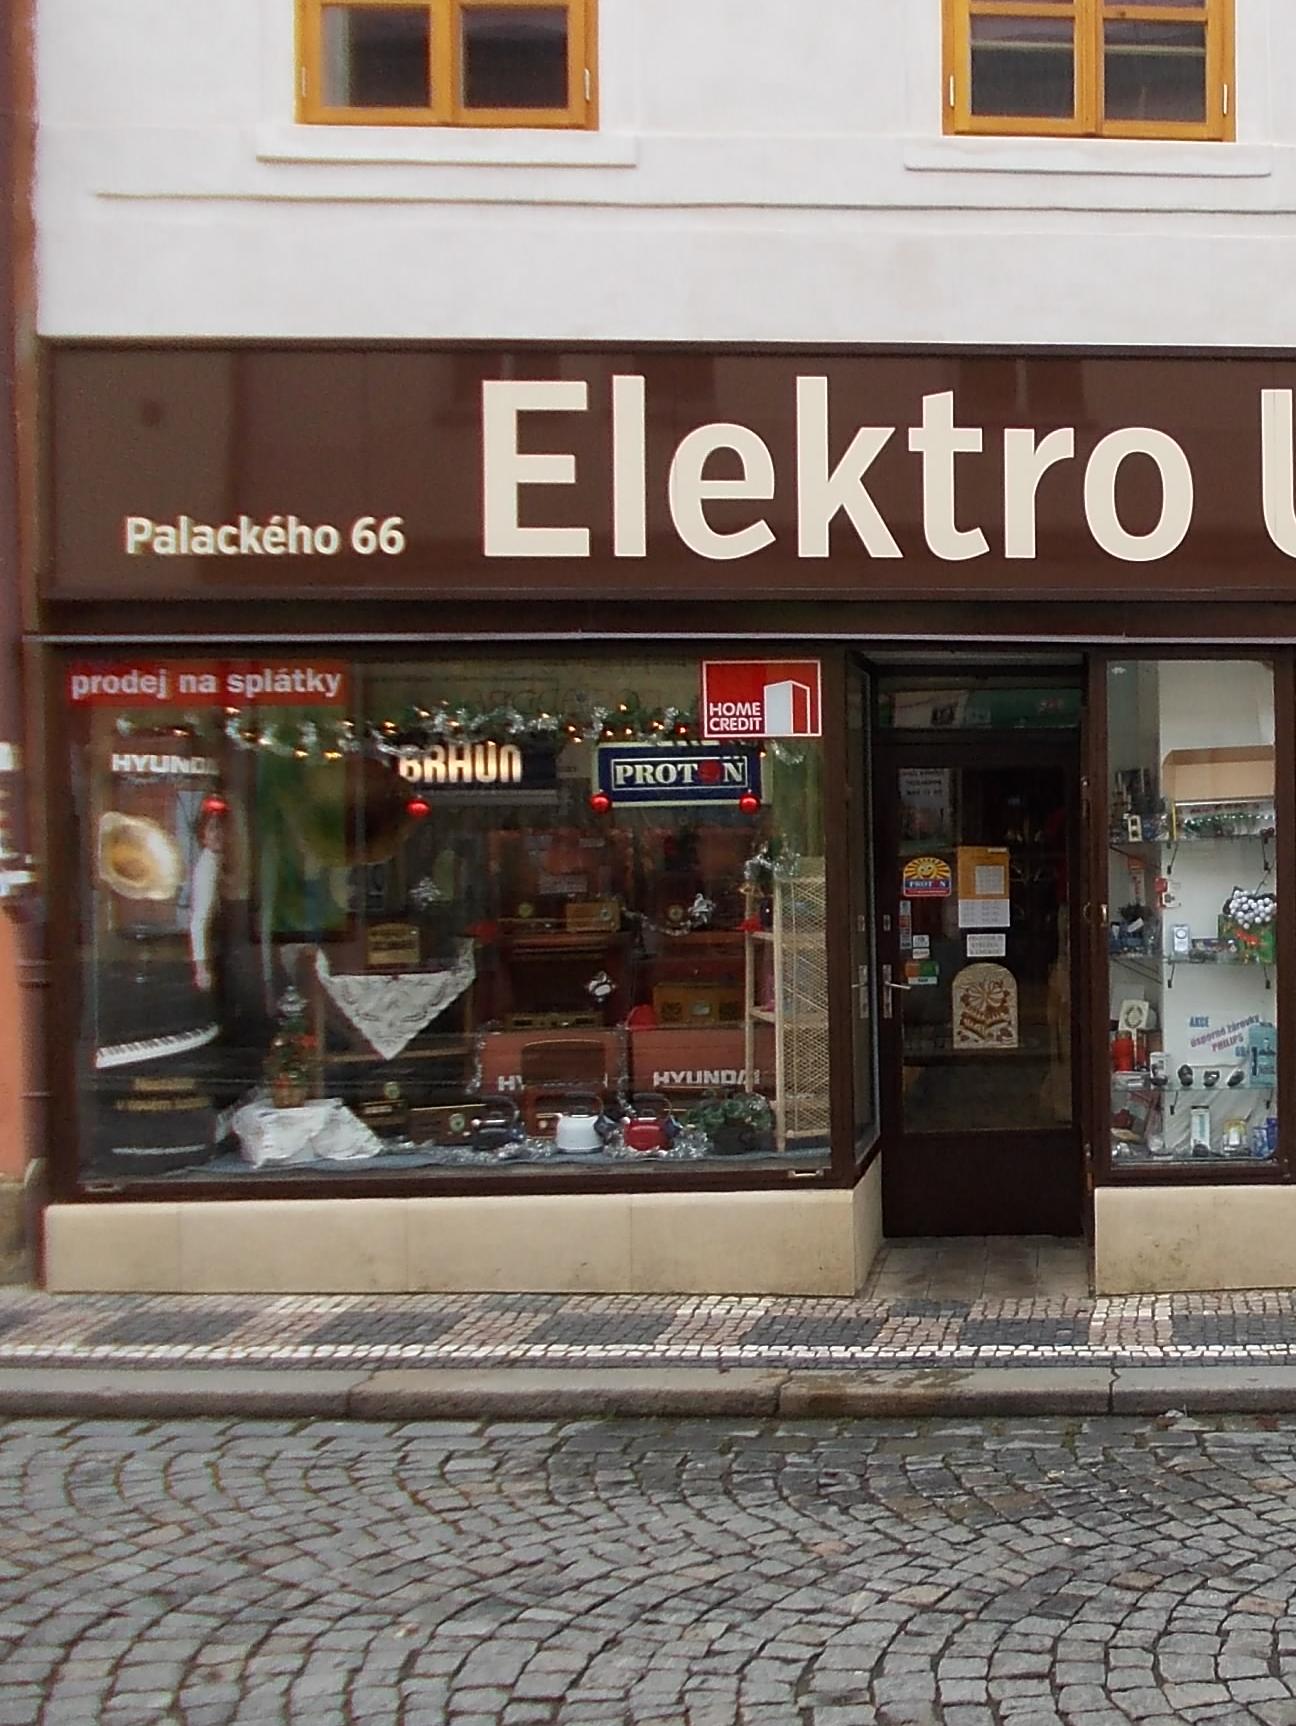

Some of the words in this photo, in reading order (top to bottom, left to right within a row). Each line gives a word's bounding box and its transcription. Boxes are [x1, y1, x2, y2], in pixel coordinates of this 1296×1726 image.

[482, 374, 1194, 562] Elektro
[125, 515, 339, 556] Palackého
[352, 516, 405, 556] 66
[71, 668, 169, 699] prodej
[179, 672, 217, 694] na
[226, 667, 342, 698] splátky
[709, 702, 761, 716] HOME
[709, 717, 763, 731] CREDIT
[112, 753, 221, 775] HYUND
[398, 741, 523, 784] BRAUN
[613, 760, 746, 787] PROTON
